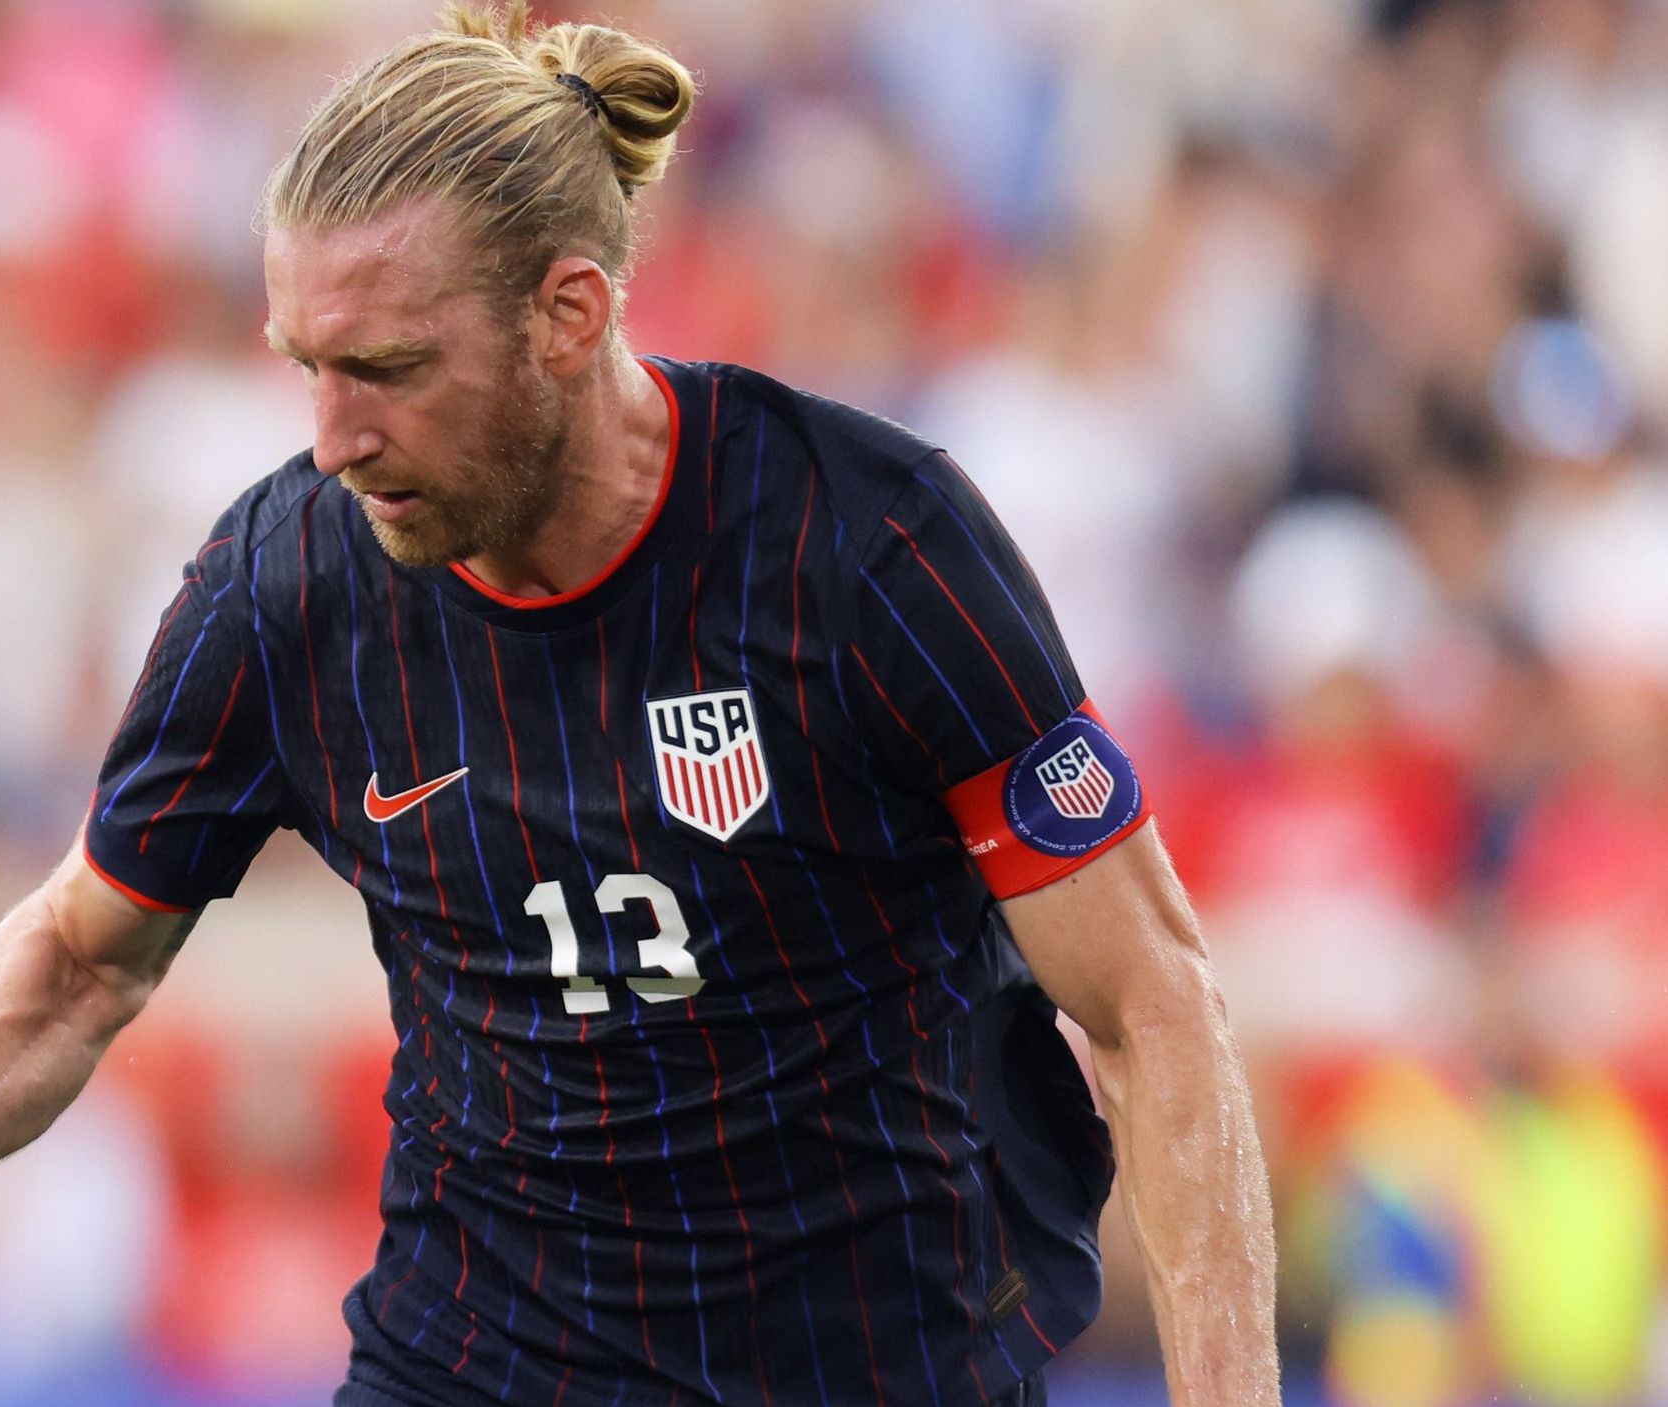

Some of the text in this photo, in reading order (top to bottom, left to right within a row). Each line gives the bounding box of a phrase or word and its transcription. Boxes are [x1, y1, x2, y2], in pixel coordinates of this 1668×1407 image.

[655, 697, 750, 756] USA
[1039, 741, 1090, 785] USA
[523, 873, 708, 1014] 13
